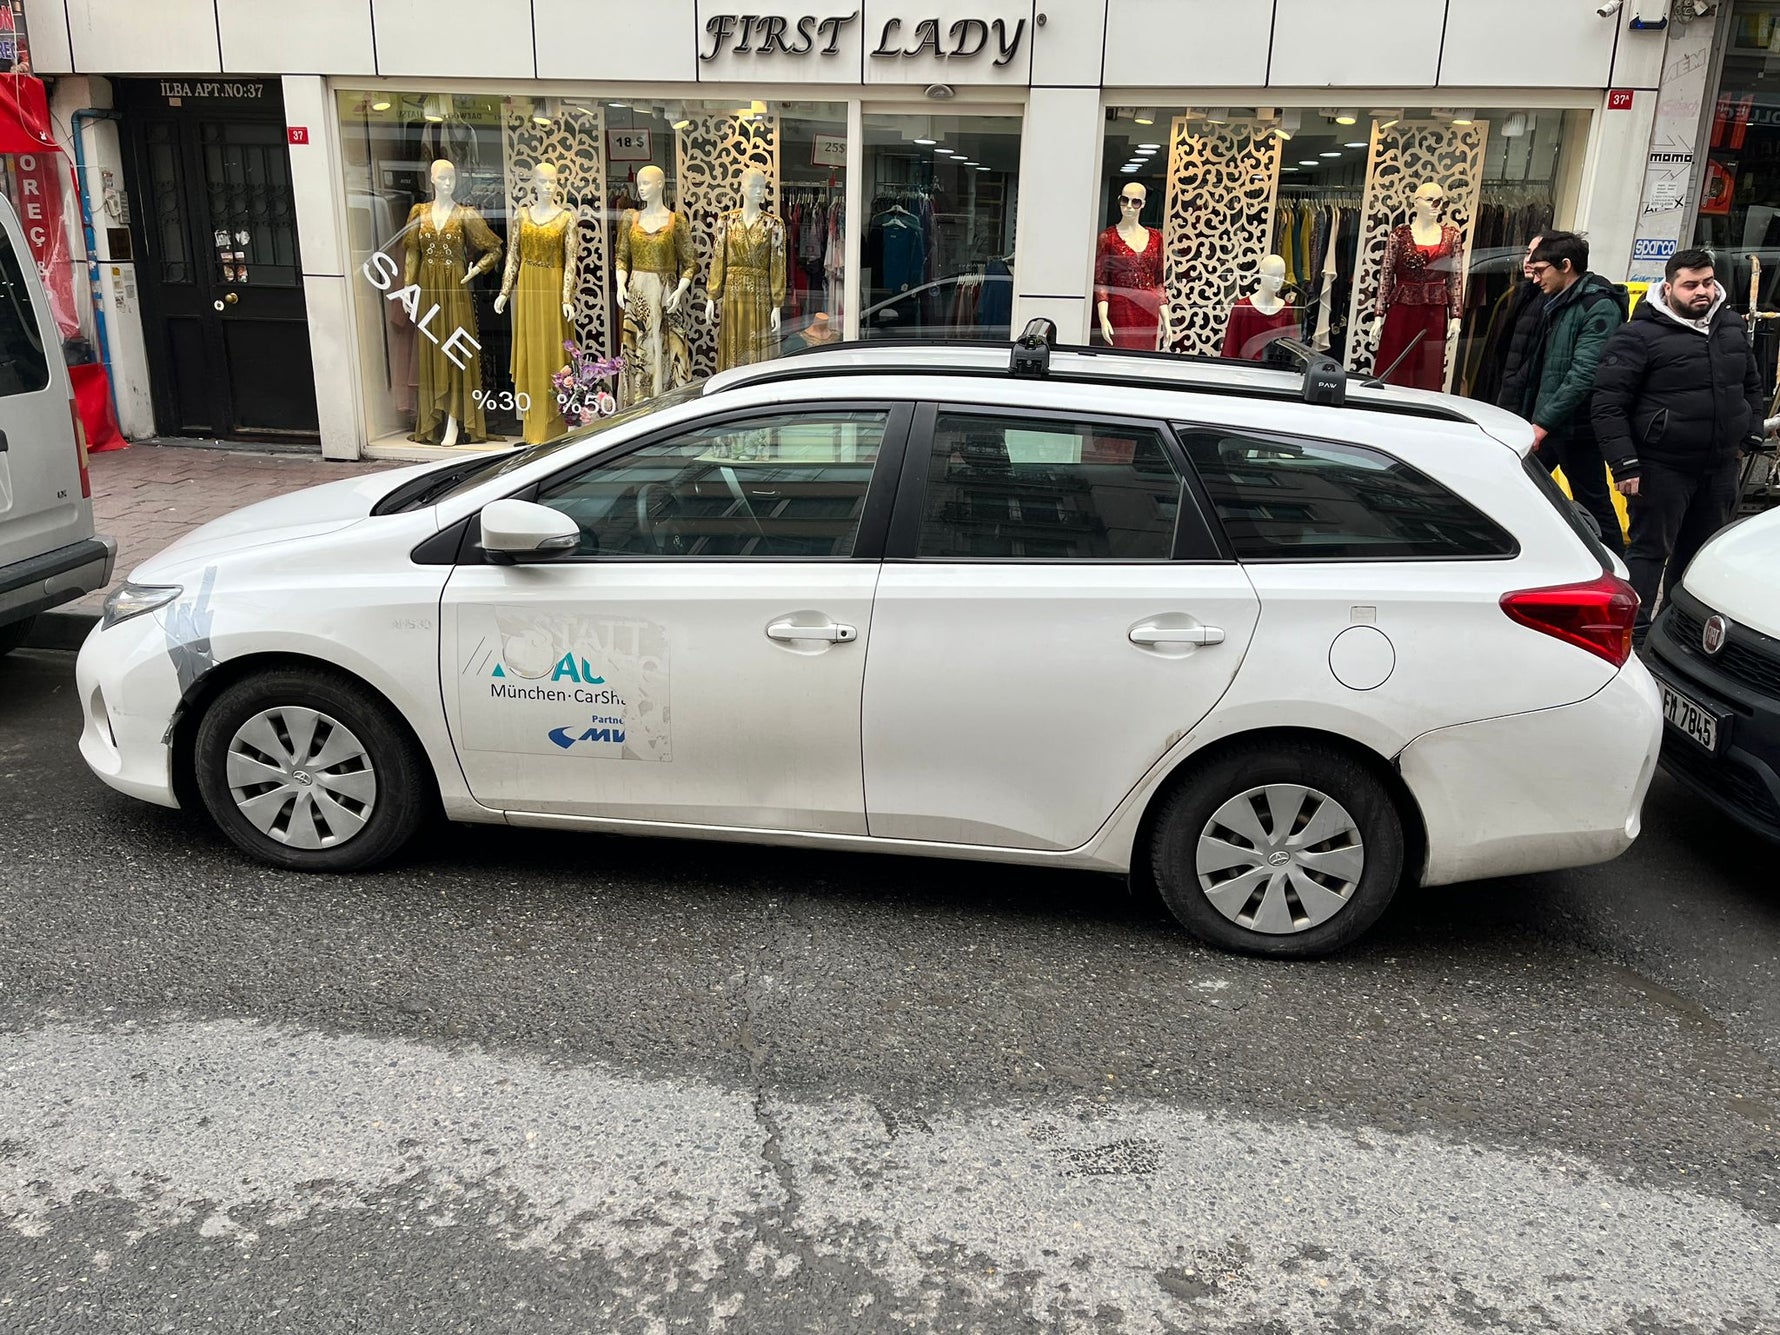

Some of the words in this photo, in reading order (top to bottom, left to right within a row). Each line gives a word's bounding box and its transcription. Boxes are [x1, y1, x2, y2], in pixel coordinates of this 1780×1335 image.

[700, 11, 860, 62] FIRST
[870, 18, 1027, 67] LADY
[293, 130, 304, 140] 37
[616, 136, 632, 148] 18
[824, 141, 846, 154] 25$
[1635, 240, 1676, 259] sparco
[362, 251, 482, 371] SALE
[1318, 381, 1338, 389] PAW
[471, 389, 531, 412] %30
[556, 393, 616, 416] %50
[1680, 701, 1711, 746] 7845
